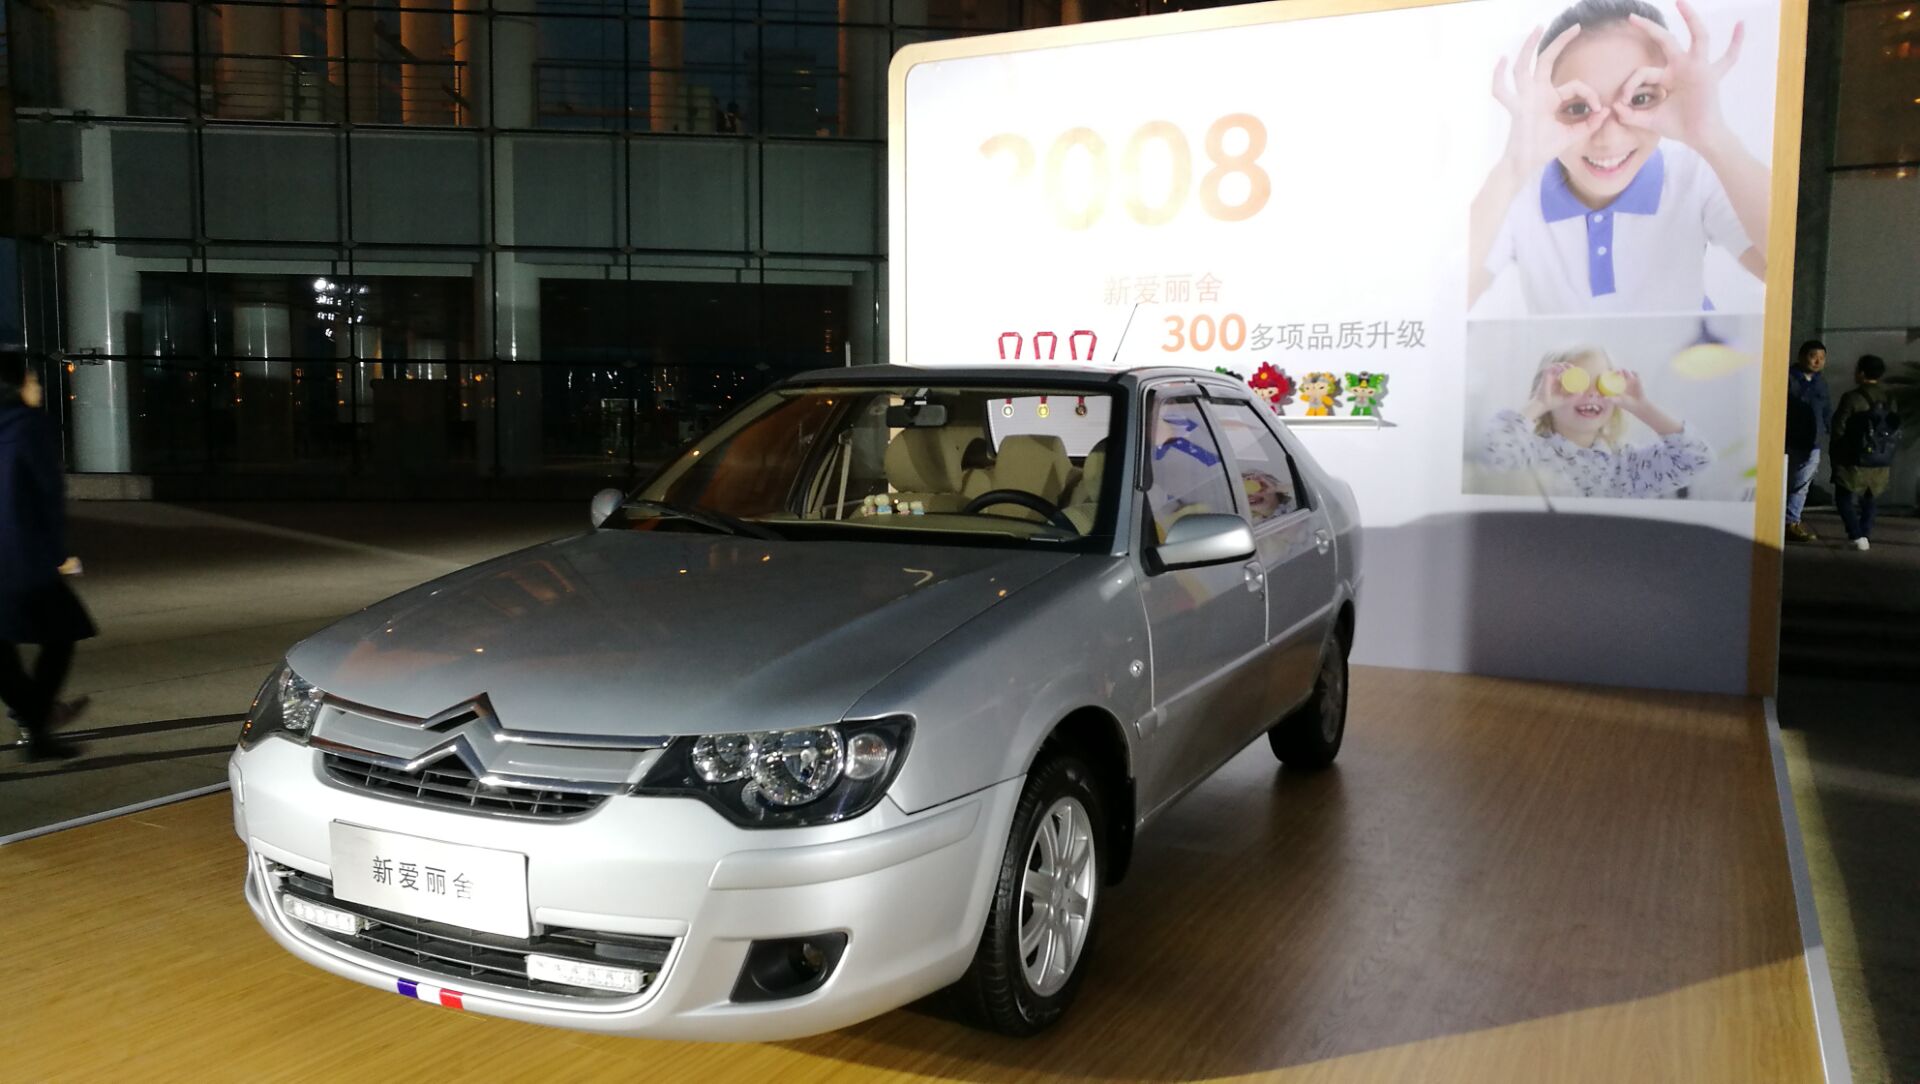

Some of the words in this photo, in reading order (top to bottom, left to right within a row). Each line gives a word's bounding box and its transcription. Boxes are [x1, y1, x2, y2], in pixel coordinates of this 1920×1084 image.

[1104, 272, 1223, 306] 新爱丽舍
[372, 855, 474, 899] 新爱丽舍
